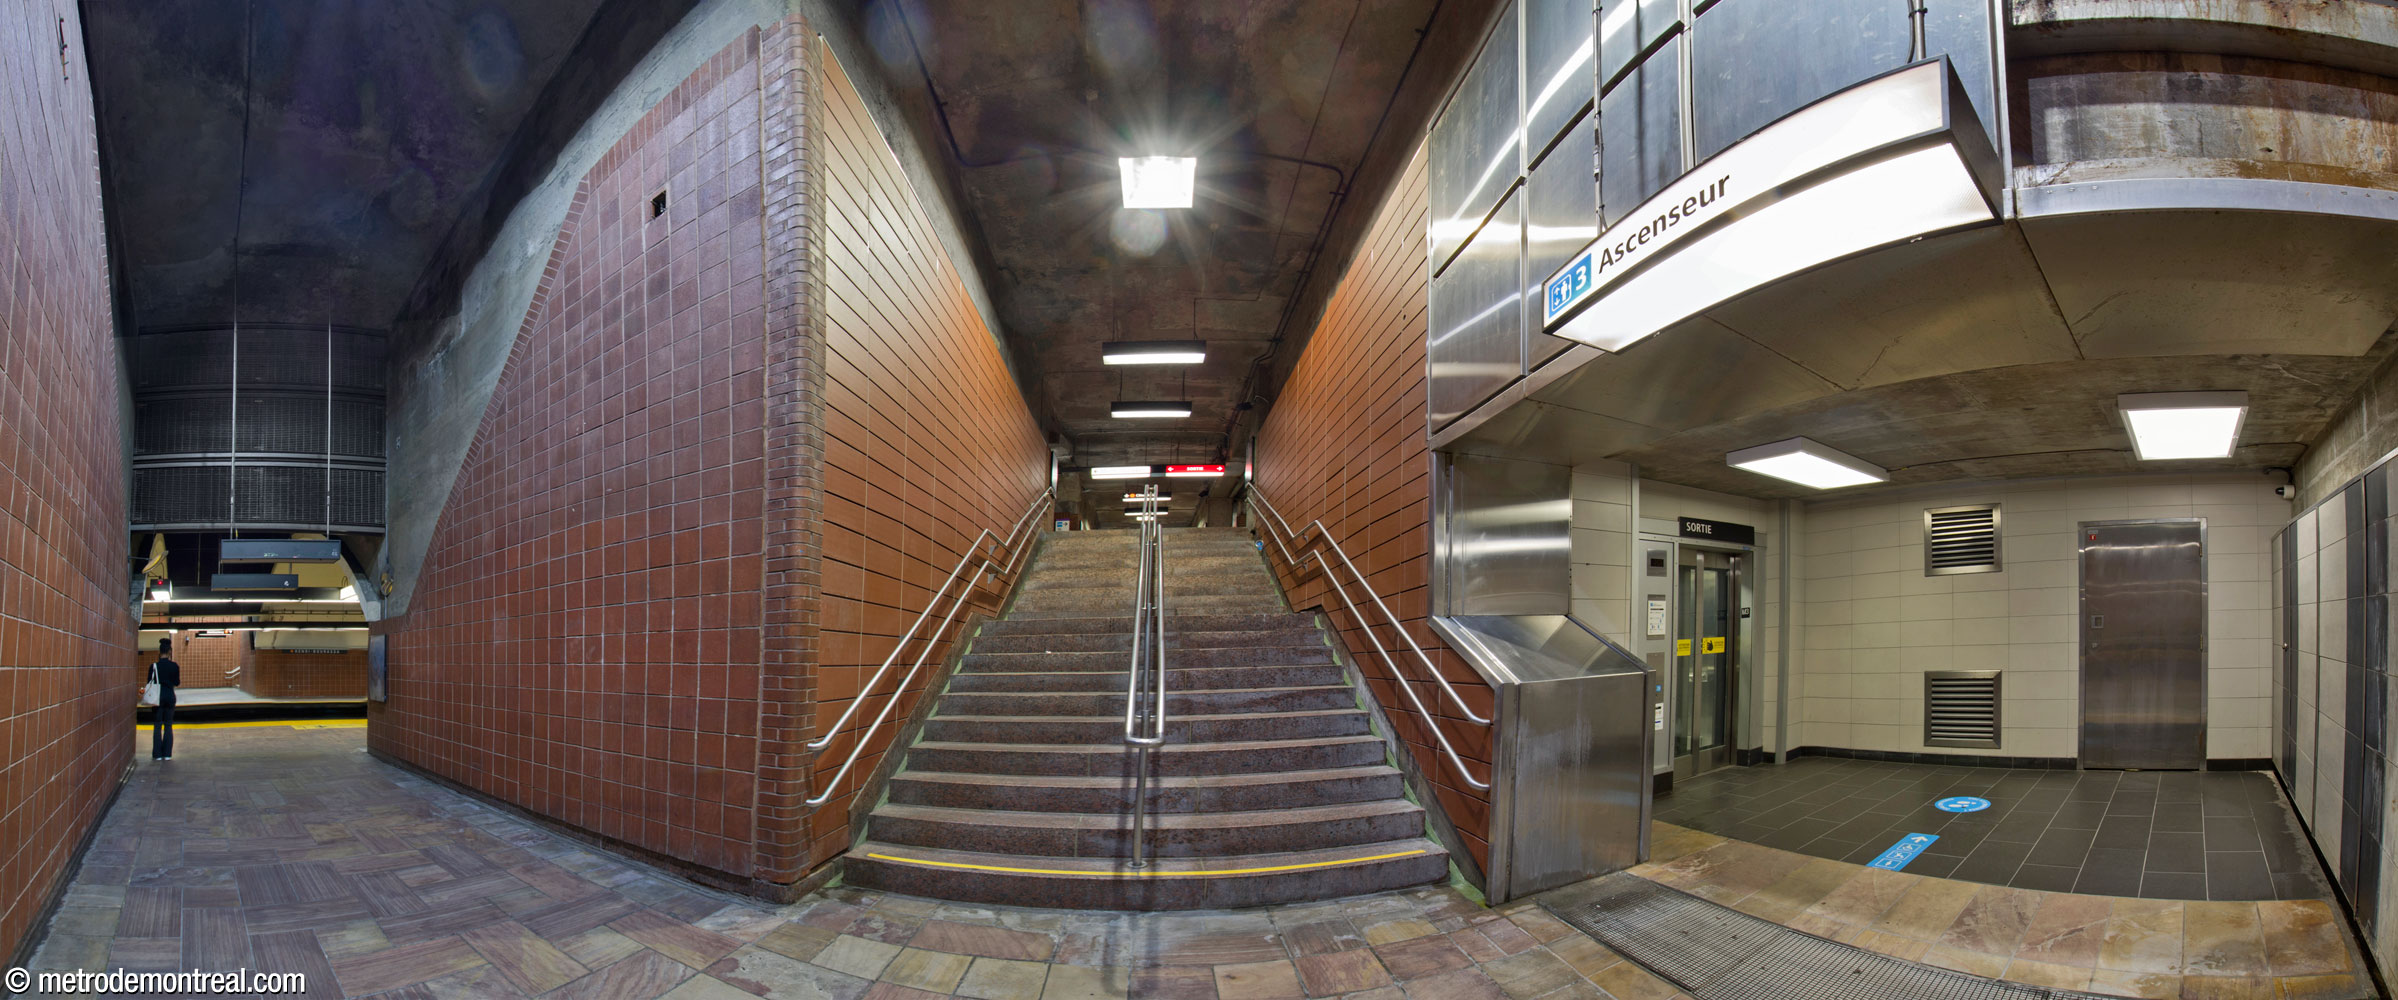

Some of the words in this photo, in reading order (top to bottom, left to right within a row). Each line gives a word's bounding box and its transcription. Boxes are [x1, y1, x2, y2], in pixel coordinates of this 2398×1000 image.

[1575, 265, 1587, 291] 3
[1598, 174, 1730, 274] Ascenseur
[1686, 521, 1712, 534] SORTIE
